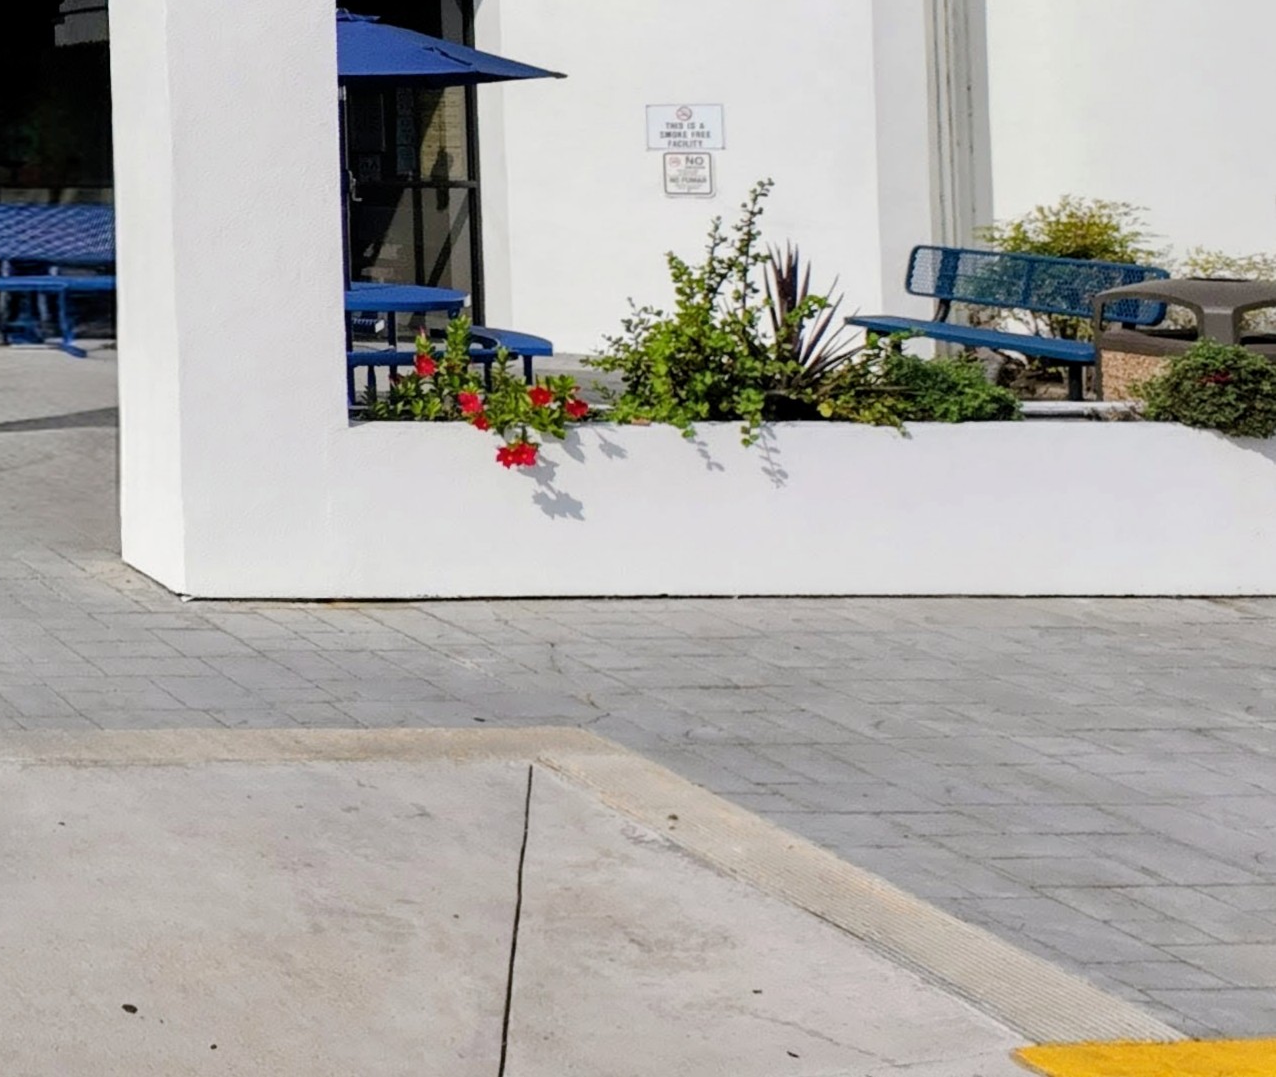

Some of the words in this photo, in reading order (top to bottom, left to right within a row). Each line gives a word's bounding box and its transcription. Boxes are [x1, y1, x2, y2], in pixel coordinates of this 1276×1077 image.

[665, 122, 684, 130] THIS
[687, 122, 696, 130] IS
[699, 122, 705, 130] A
[659, 131, 687, 139] SMOKE
[691, 131, 711, 139] FREE
[667, 140, 703, 148] FACILITY
[685, 156, 704, 166] NO
